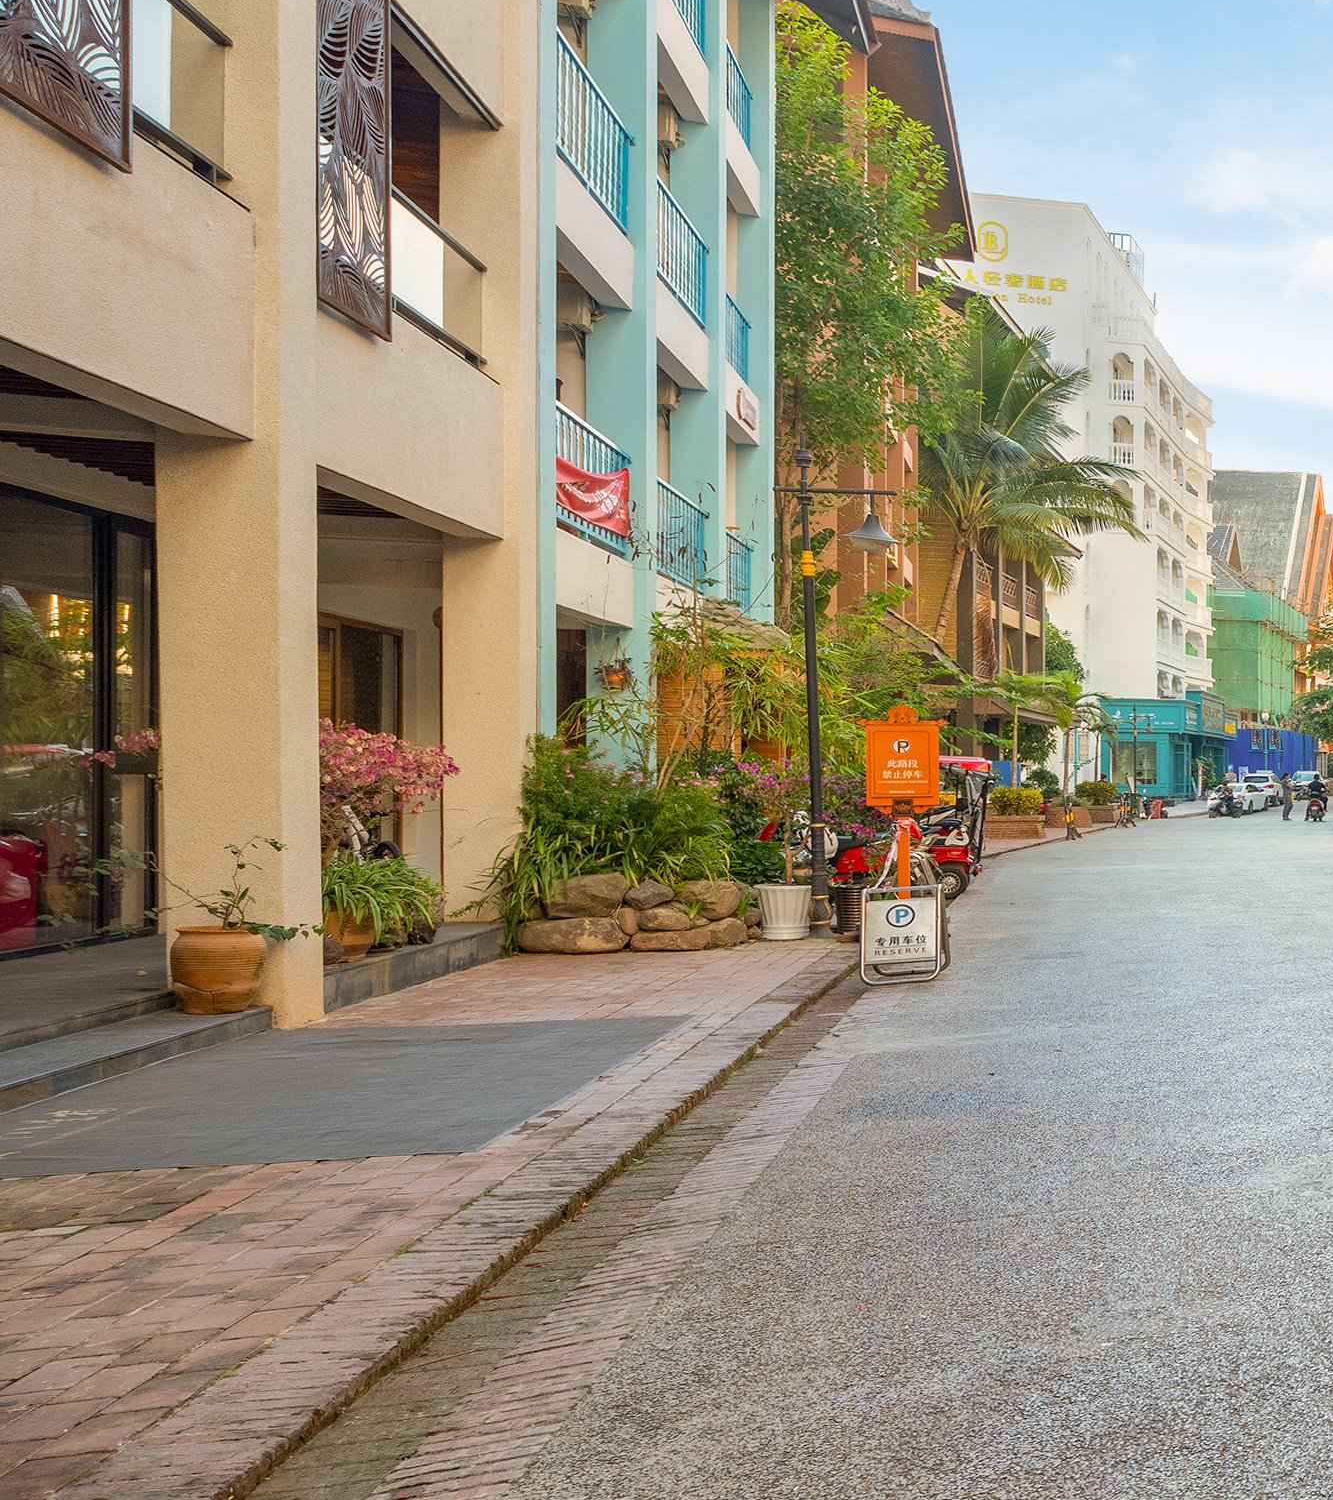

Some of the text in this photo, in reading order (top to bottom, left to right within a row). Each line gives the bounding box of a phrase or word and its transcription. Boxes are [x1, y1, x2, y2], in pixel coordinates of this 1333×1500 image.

[1018, 293, 1052, 306] Hotel
[887, 759, 918, 769] 此路段
[882, 770, 923, 779] 禁止停车
[895, 909, 909, 923] P
[874, 934, 927, 947] 专用车位
[874, 947, 927, 956] RESERVE
